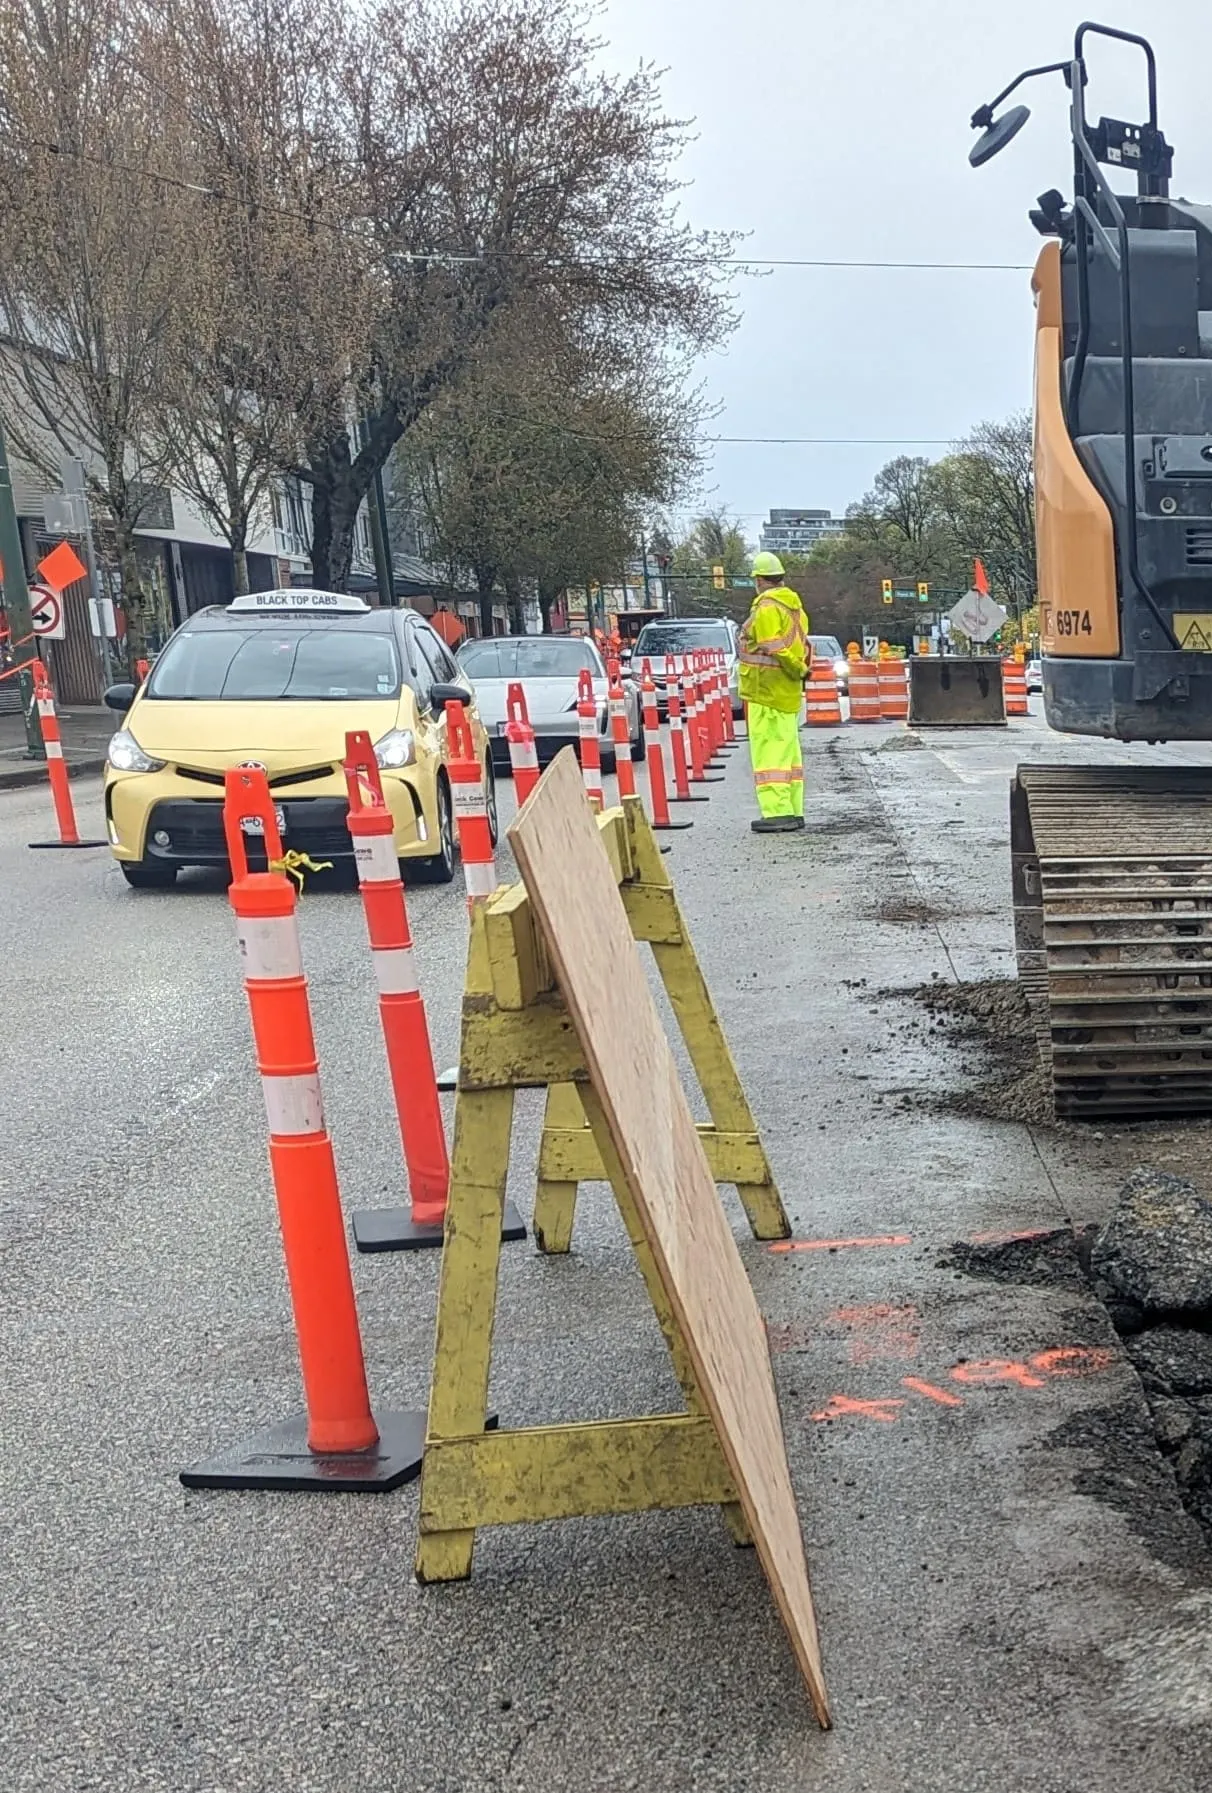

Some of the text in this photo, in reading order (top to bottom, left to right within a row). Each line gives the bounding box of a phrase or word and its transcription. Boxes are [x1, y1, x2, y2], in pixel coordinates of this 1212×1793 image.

[256, 595, 338, 605] BLACK TOP CABS
[1056, 609, 1093, 636] 6974
